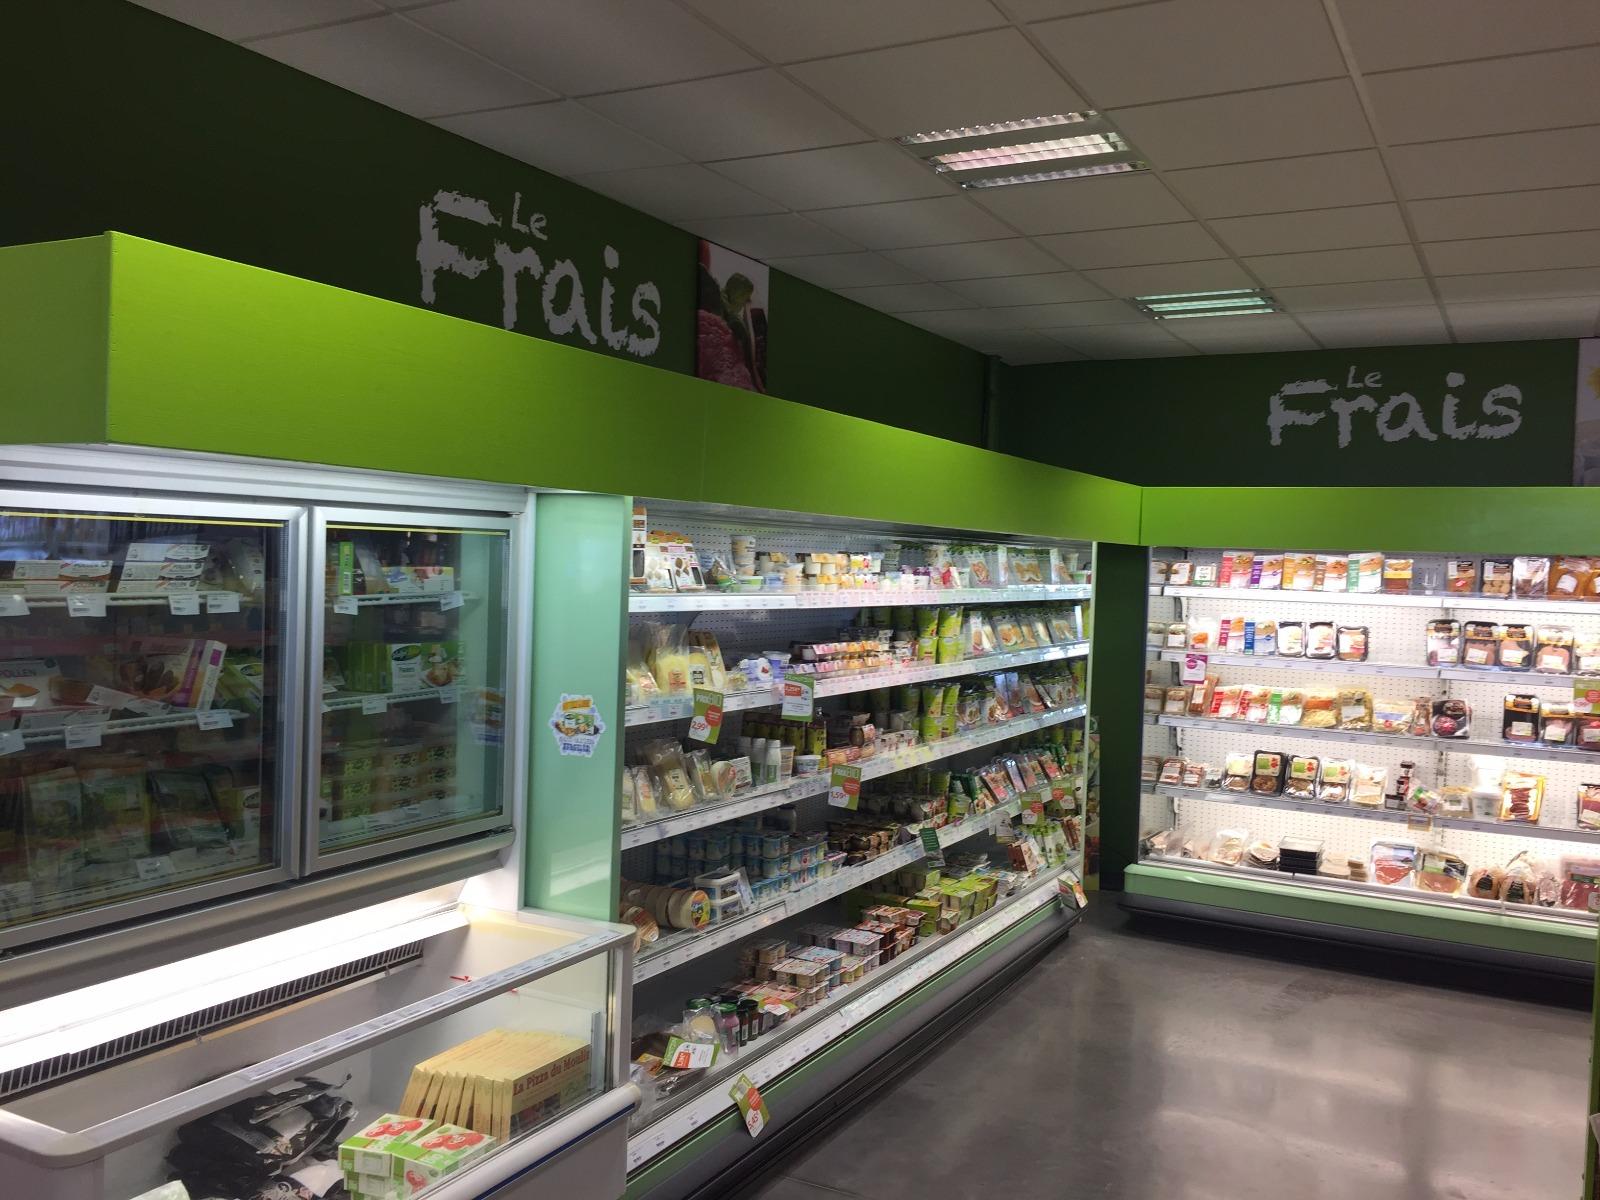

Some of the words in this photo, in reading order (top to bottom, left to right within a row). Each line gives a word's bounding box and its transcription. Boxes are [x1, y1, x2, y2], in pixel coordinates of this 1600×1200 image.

[512, 191, 547, 240] Le
[416, 188, 661, 357] Frais
[1347, 365, 1382, 388] Le
[1267, 371, 1523, 449] Frais
[512, 1082, 524, 1097] La
[526, 1071, 549, 1090] Pizza
[551, 1062, 562, 1078] du
